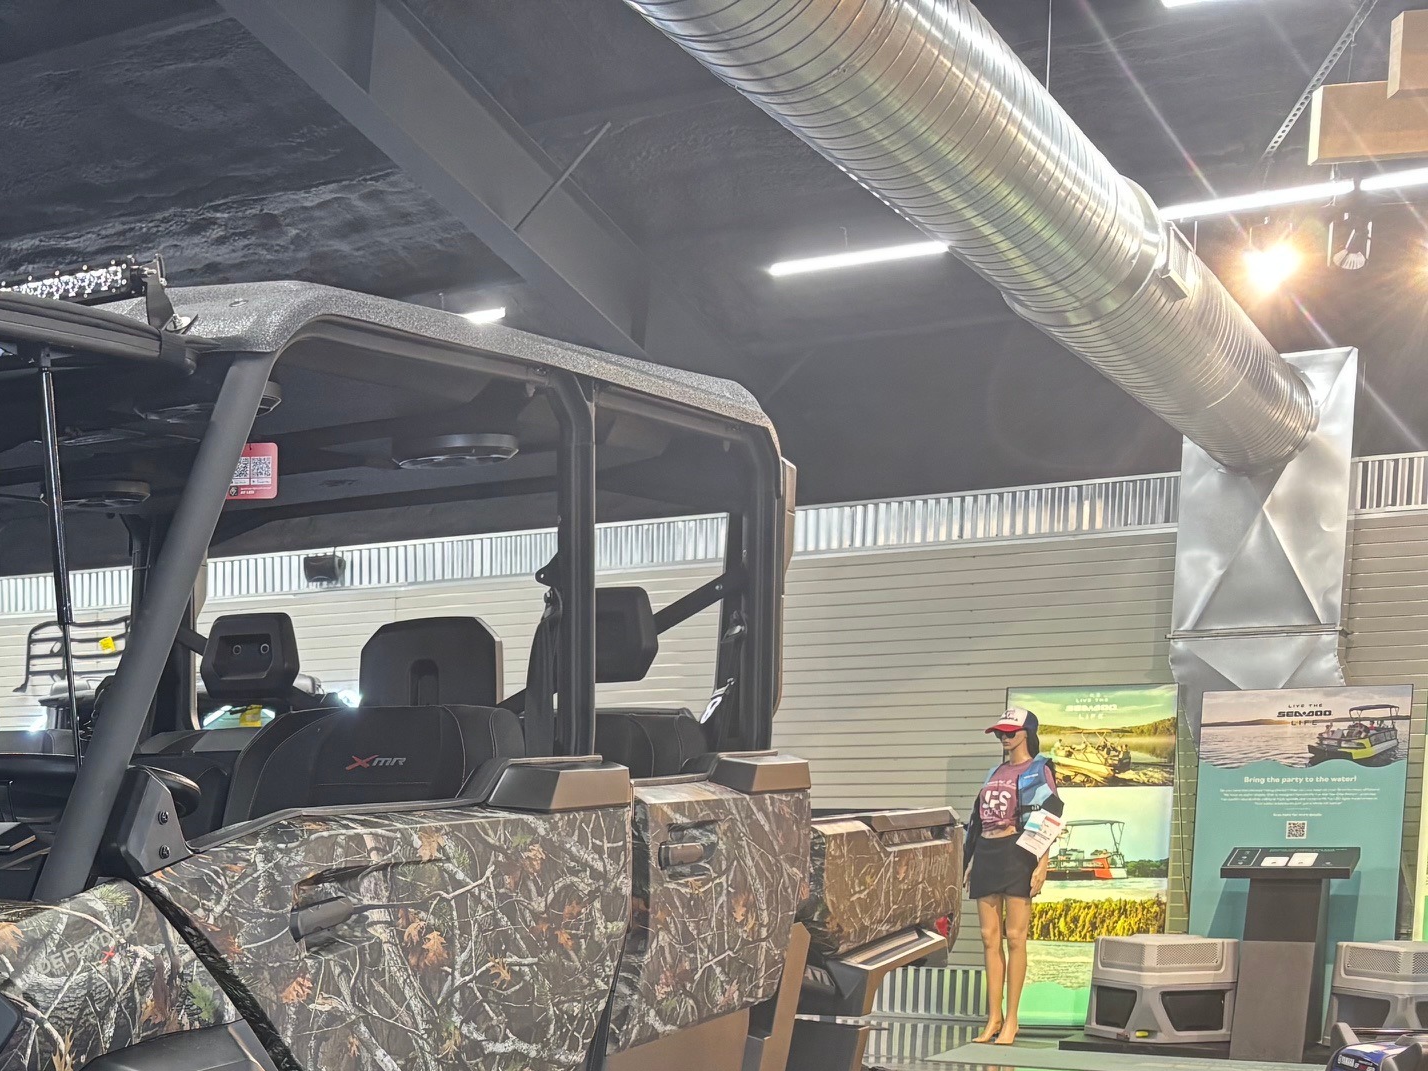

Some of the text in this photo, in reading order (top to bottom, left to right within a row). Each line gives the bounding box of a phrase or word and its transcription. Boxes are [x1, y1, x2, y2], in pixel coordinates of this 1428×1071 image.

[1243, 776, 1265, 784] Bring
[1281, 776, 1303, 784] party
[1330, 775, 1357, 783] water!
